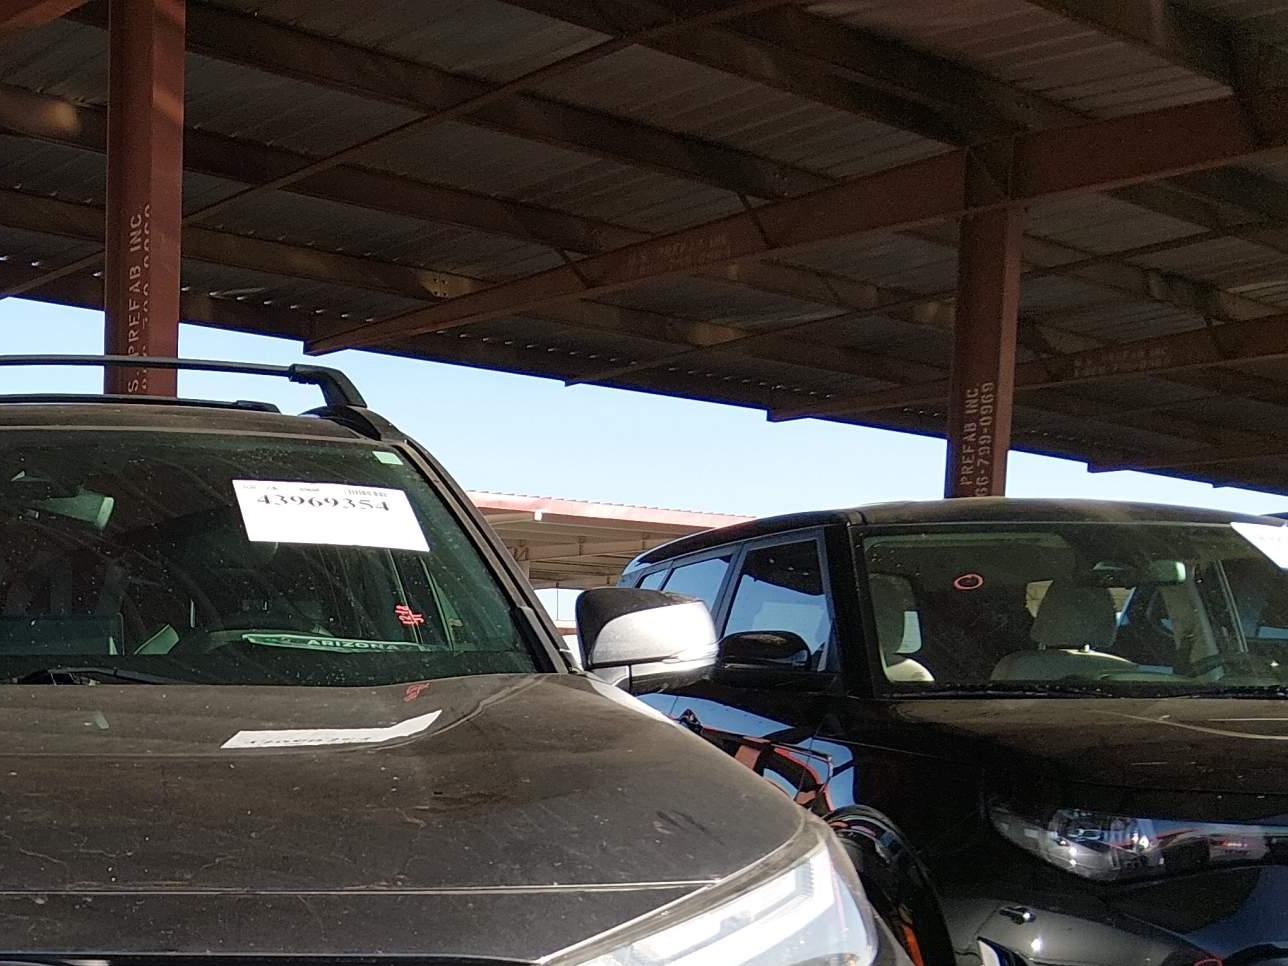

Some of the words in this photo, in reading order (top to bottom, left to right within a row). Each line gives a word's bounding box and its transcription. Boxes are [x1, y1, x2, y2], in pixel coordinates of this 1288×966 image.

[128, 265, 142, 358] PREFAB
[960, 422, 977, 486] PREFAB
[257, 494, 390, 512] 43969354
[306, 638, 400, 650] ARIZONA
